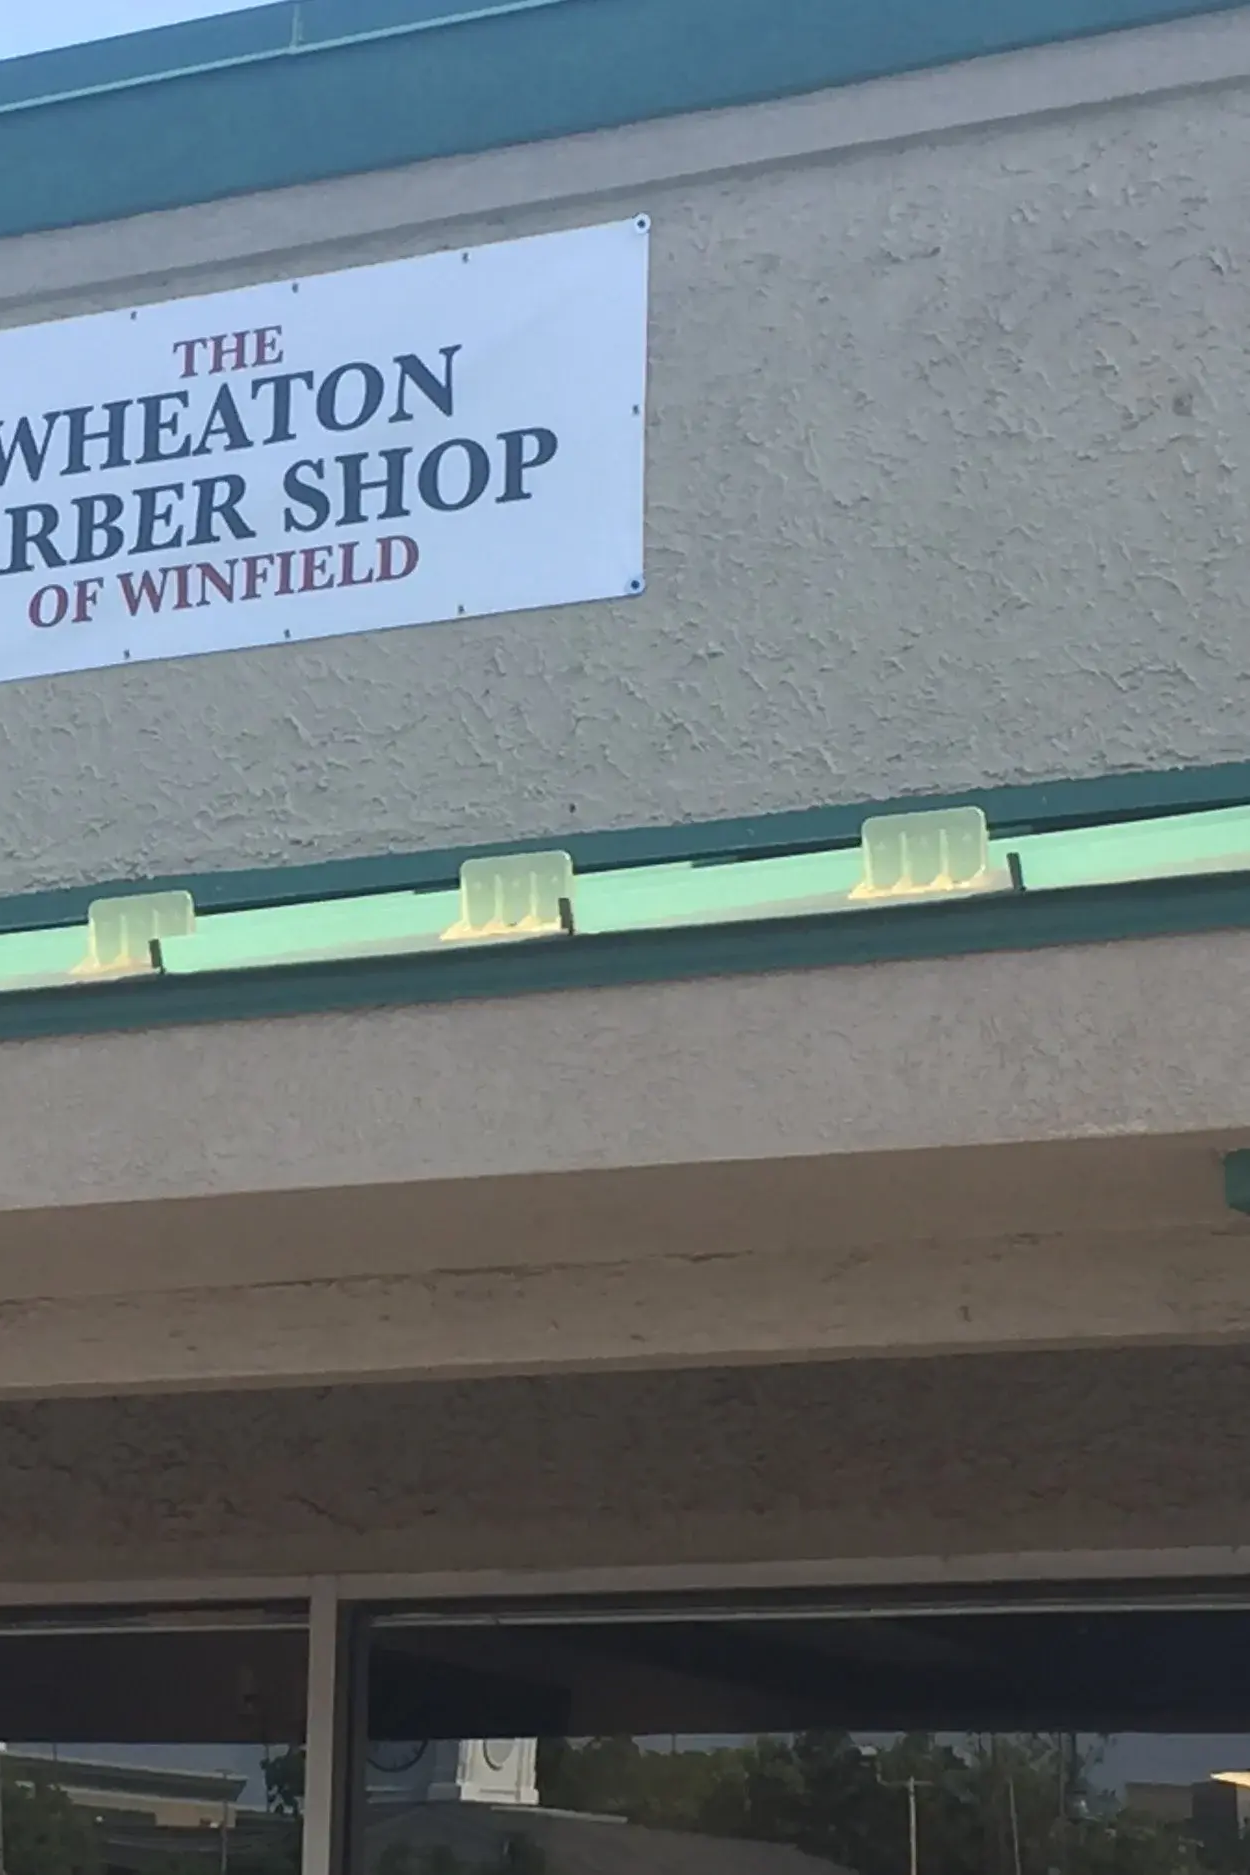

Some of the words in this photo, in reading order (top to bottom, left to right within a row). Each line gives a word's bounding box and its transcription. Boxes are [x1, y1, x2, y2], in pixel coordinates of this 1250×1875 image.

[173, 325, 284, 378] THE
[282, 428, 559, 533] SHOP
[29, 577, 105, 628] OF
[116, 535, 420, 617] WINFIELD
